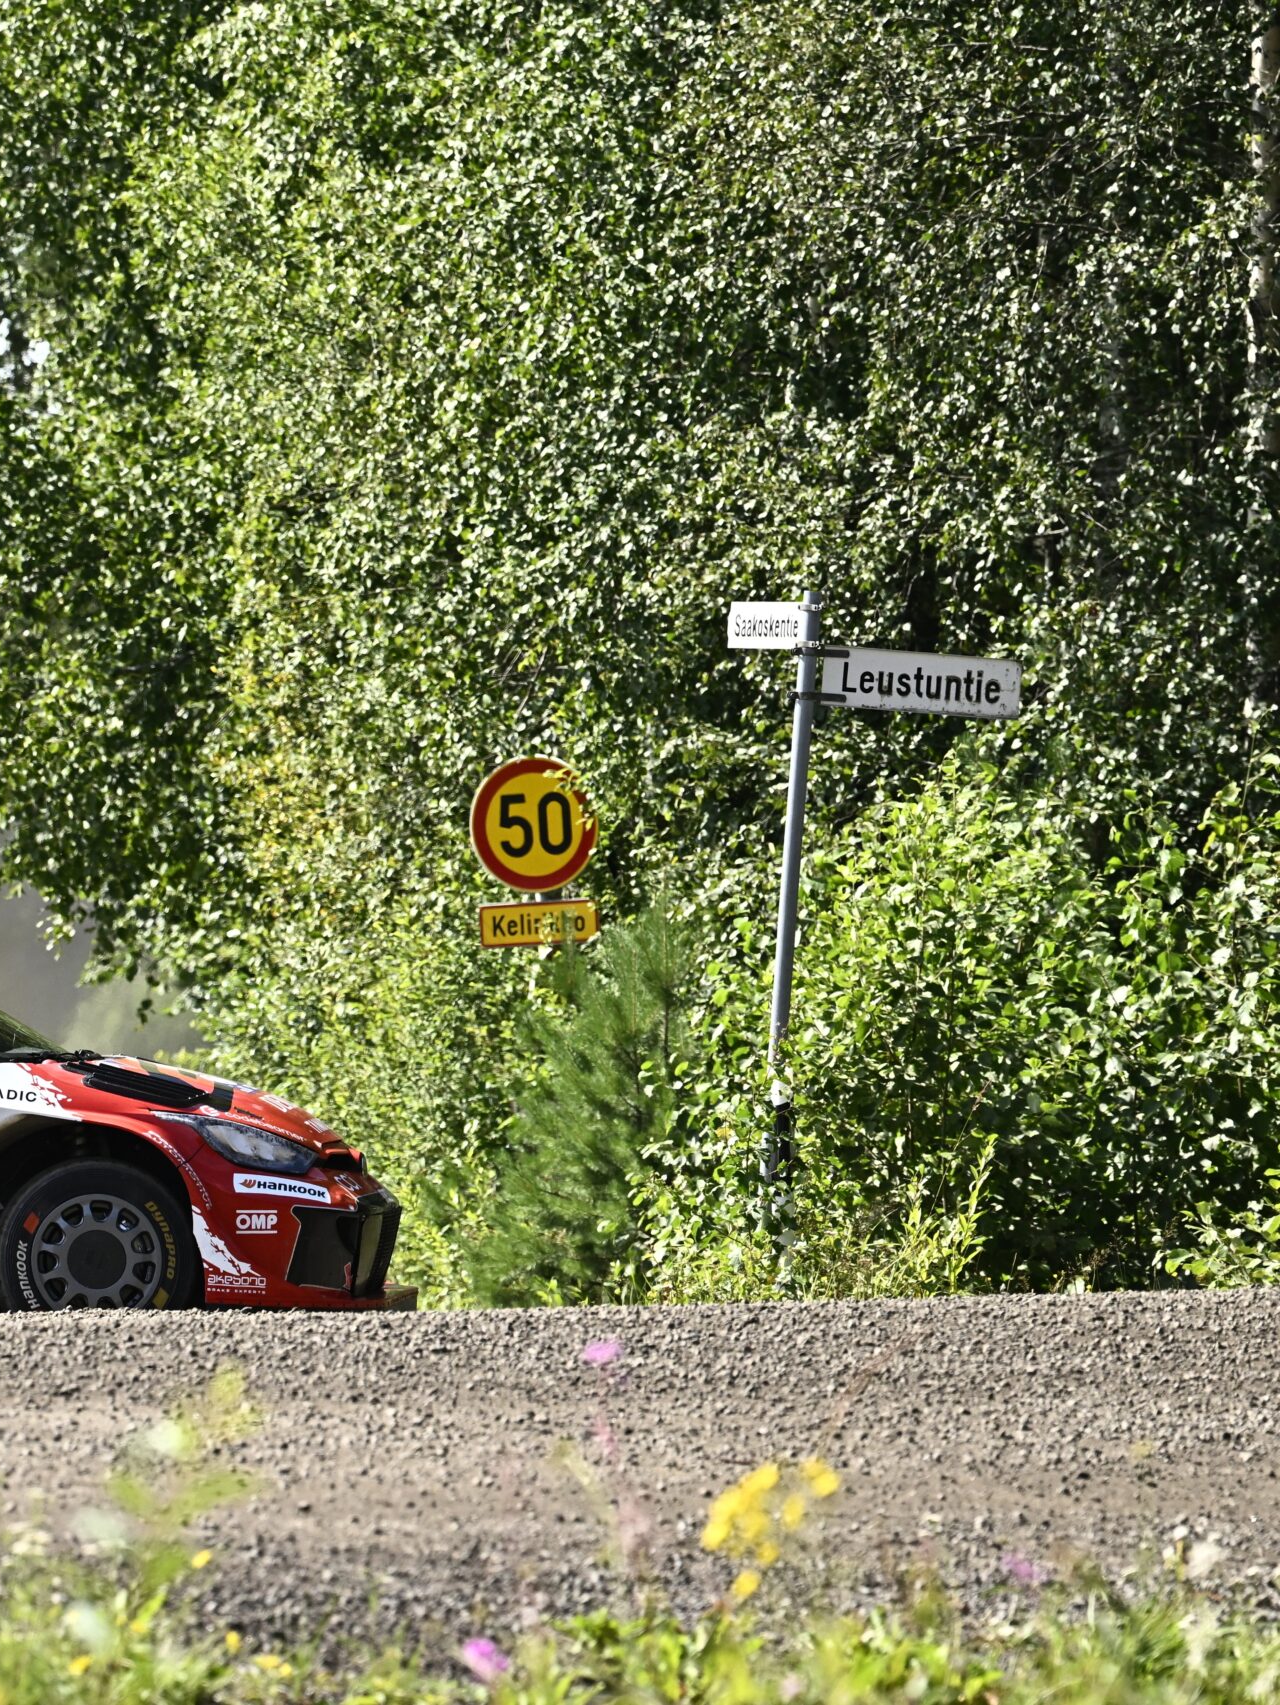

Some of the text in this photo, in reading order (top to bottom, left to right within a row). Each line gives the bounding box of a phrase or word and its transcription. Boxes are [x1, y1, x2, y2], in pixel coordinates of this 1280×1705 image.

[734, 613, 798, 638] Saakoskentie
[841, 661, 1001, 704] Leustuntie
[499, 791, 573, 858] 50
[236, 1214, 278, 1230] OMP
[207, 1274, 267, 1286] akebono
